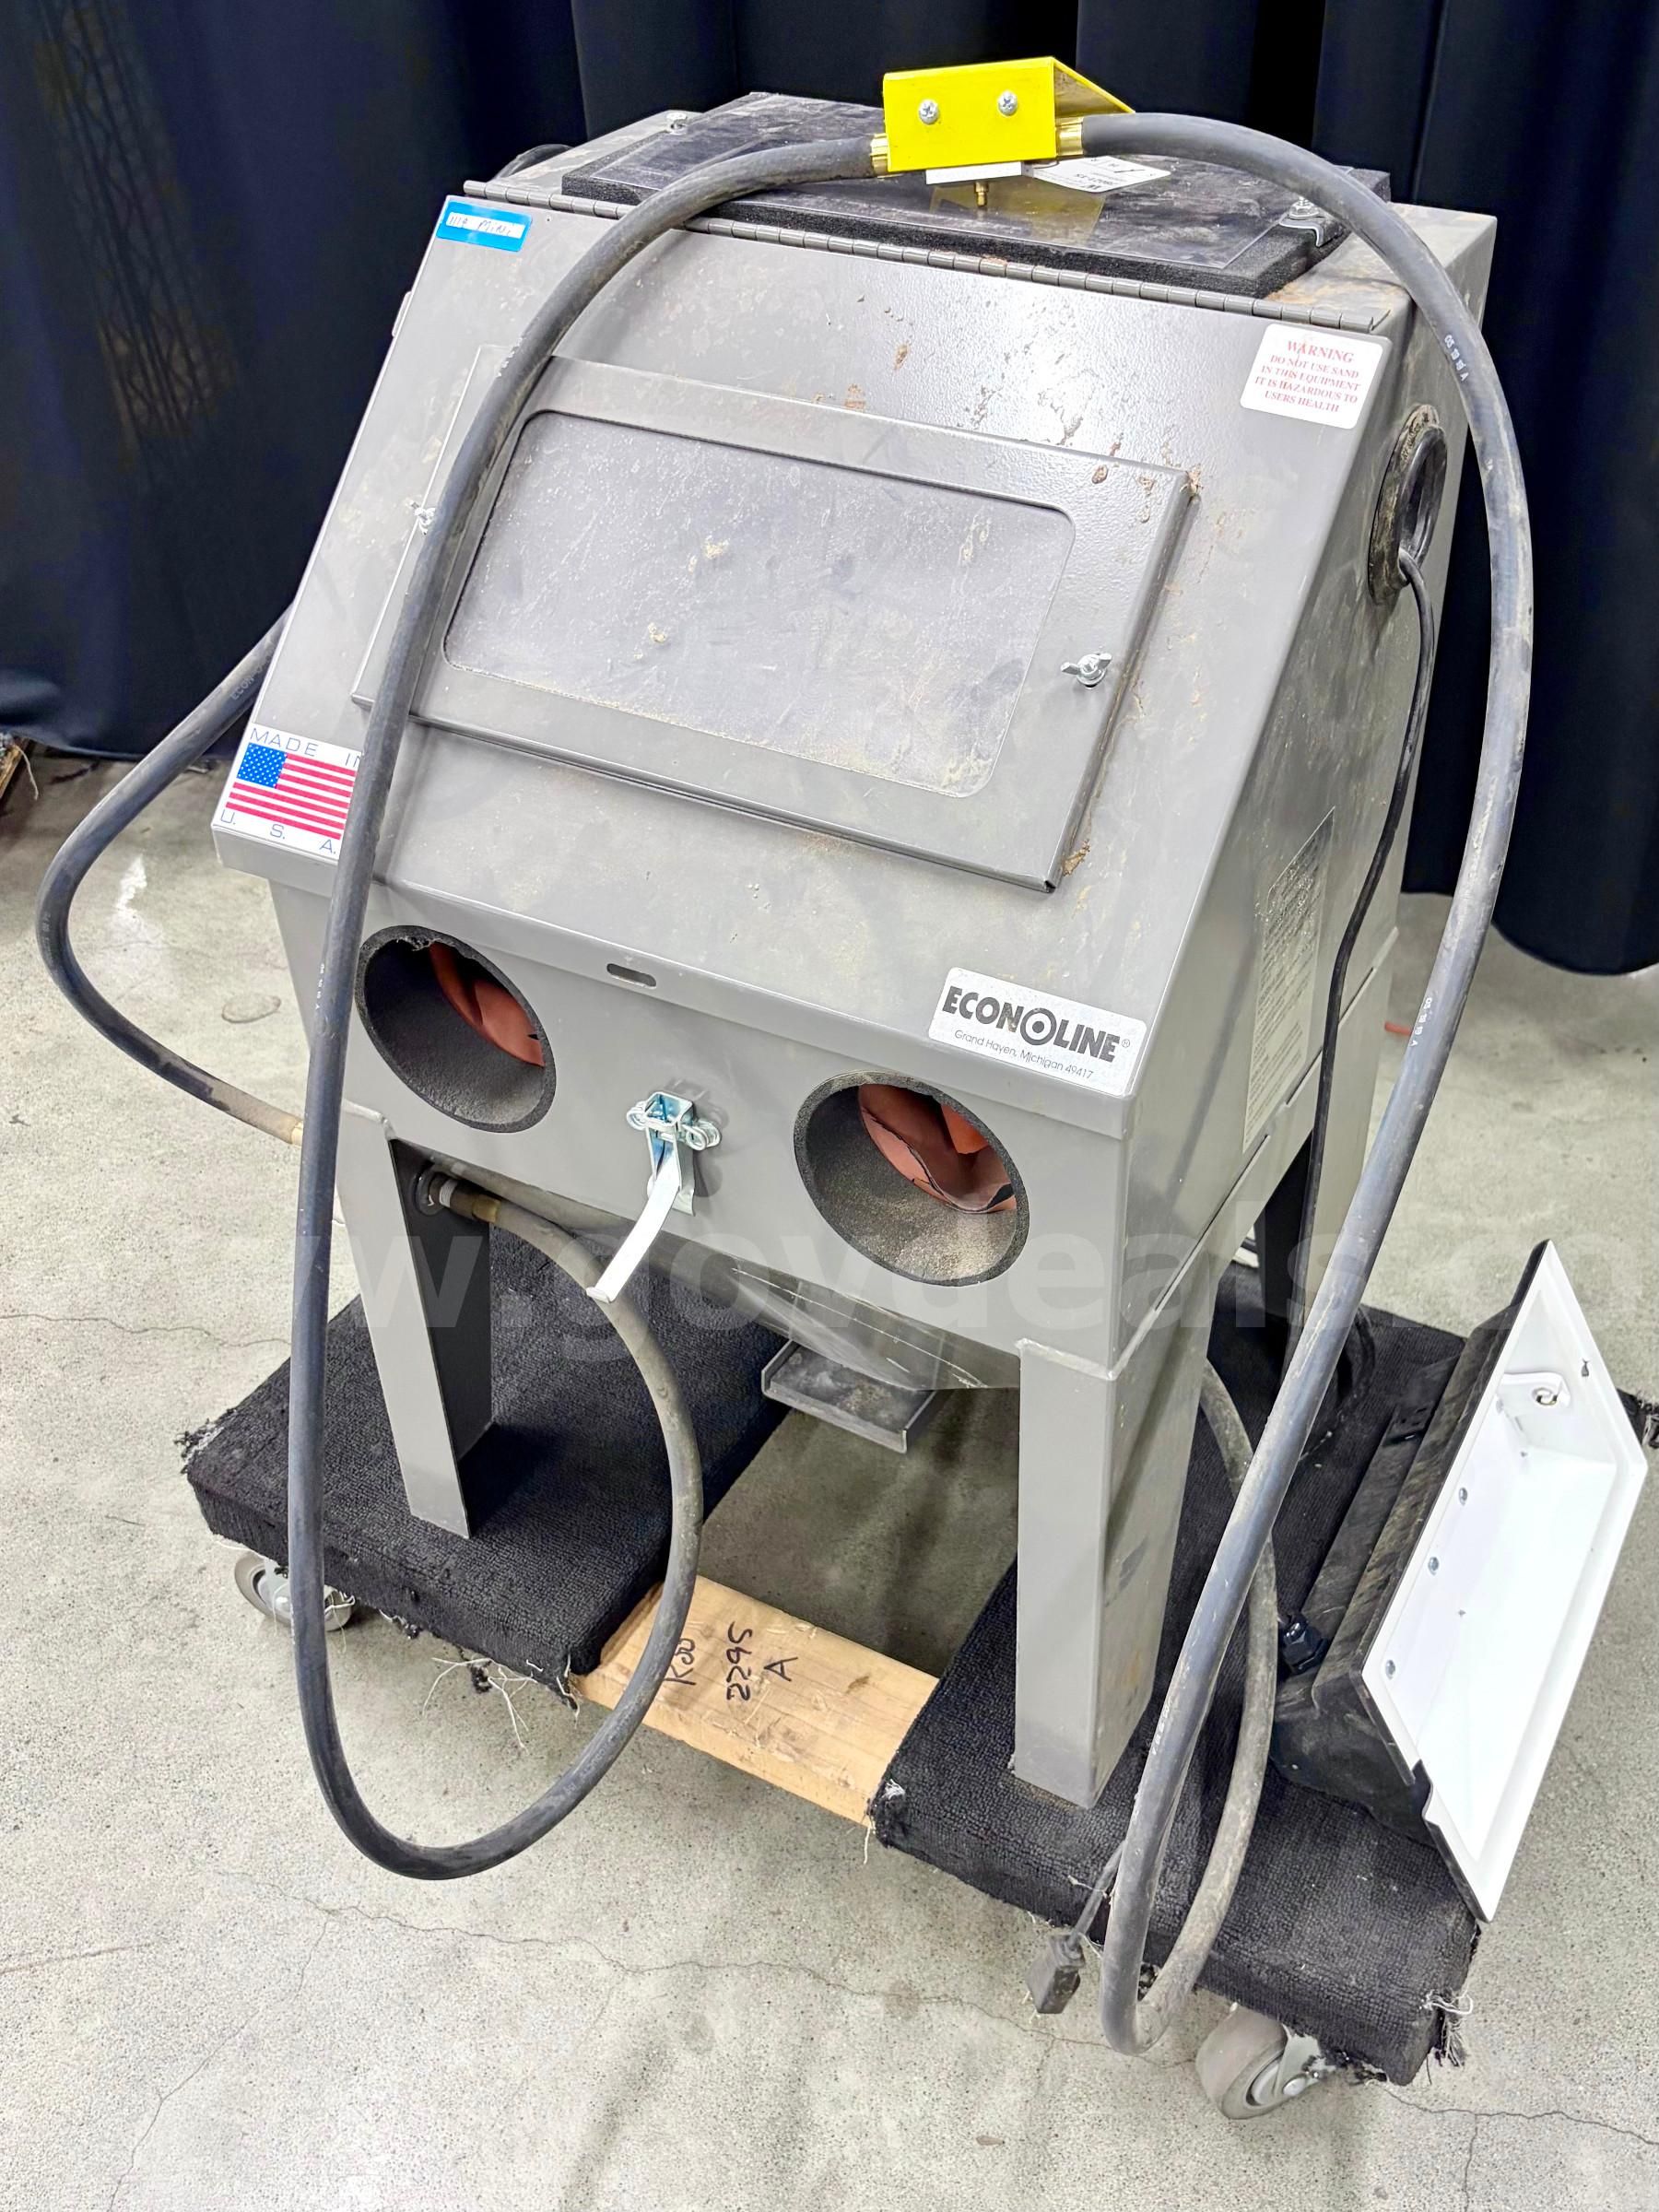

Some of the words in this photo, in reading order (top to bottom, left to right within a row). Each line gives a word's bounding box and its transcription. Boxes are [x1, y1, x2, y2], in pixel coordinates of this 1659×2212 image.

[1287, 340, 1355, 364] WARNING
[1261, 365, 1273, 374] IN
[1275, 368, 1297, 379] THIS
[1300, 372, 1360, 391] EQUIPMENT
[1270, 354, 1286, 365] DO
[1288, 358, 1309, 369] NOT
[1311, 361, 1329, 372] USE
[1331, 366, 1359, 379] SAND
[1254, 376, 1267, 385] IT
[1267, 378, 1278, 388] IS
[1279, 380, 1342, 402] HAZARDOUS
[1344, 393, 1359, 404] TO
[1265, 390, 1296, 404] USERS
[1298, 396, 1340, 413] HEALTH
[250, 727, 319, 758] MADE
[942, 985, 1121, 1063] ECONOLINE
[954, 1029, 985, 1048] Grand
[985, 1040, 1018, 1057] Haven,
[1019, 1049, 1064, 1070] Michigan
[1065, 1063, 1094, 1080] 49417
[763, 1655, 800, 1683] A
